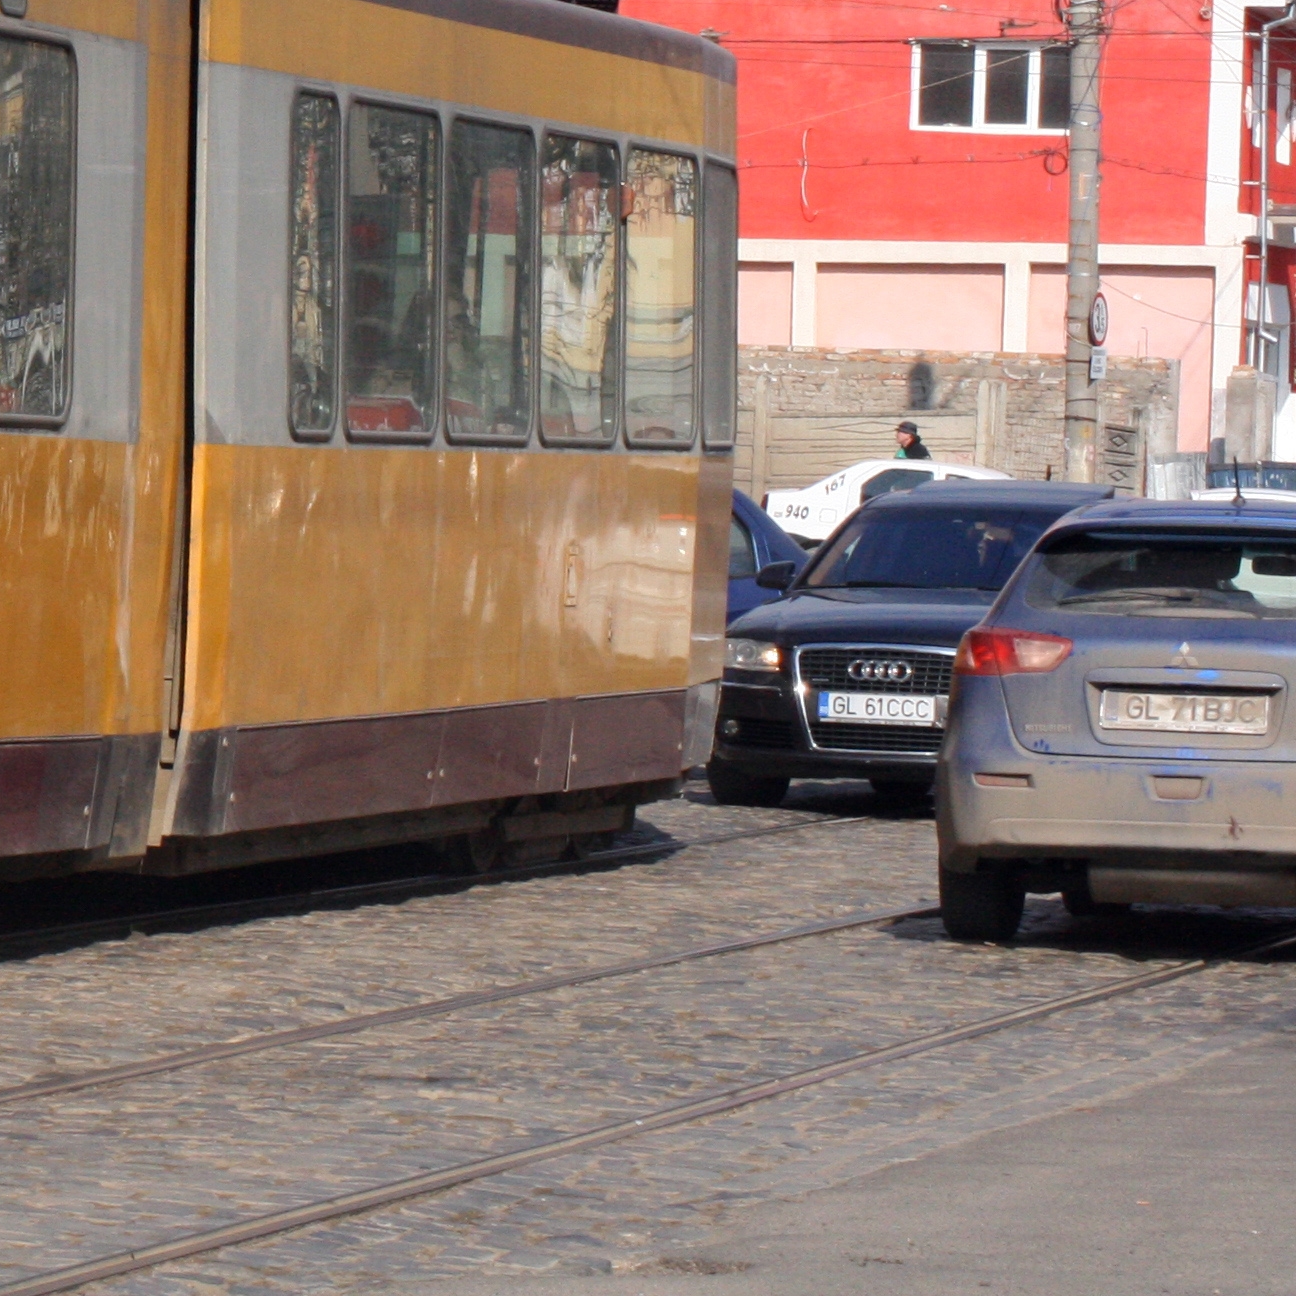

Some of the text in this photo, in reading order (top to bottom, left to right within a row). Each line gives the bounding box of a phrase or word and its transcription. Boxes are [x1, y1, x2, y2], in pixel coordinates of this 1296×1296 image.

[785, 504, 810, 521] 940
[832, 696, 857, 715] GL
[1125, 695, 1159, 721] GL
